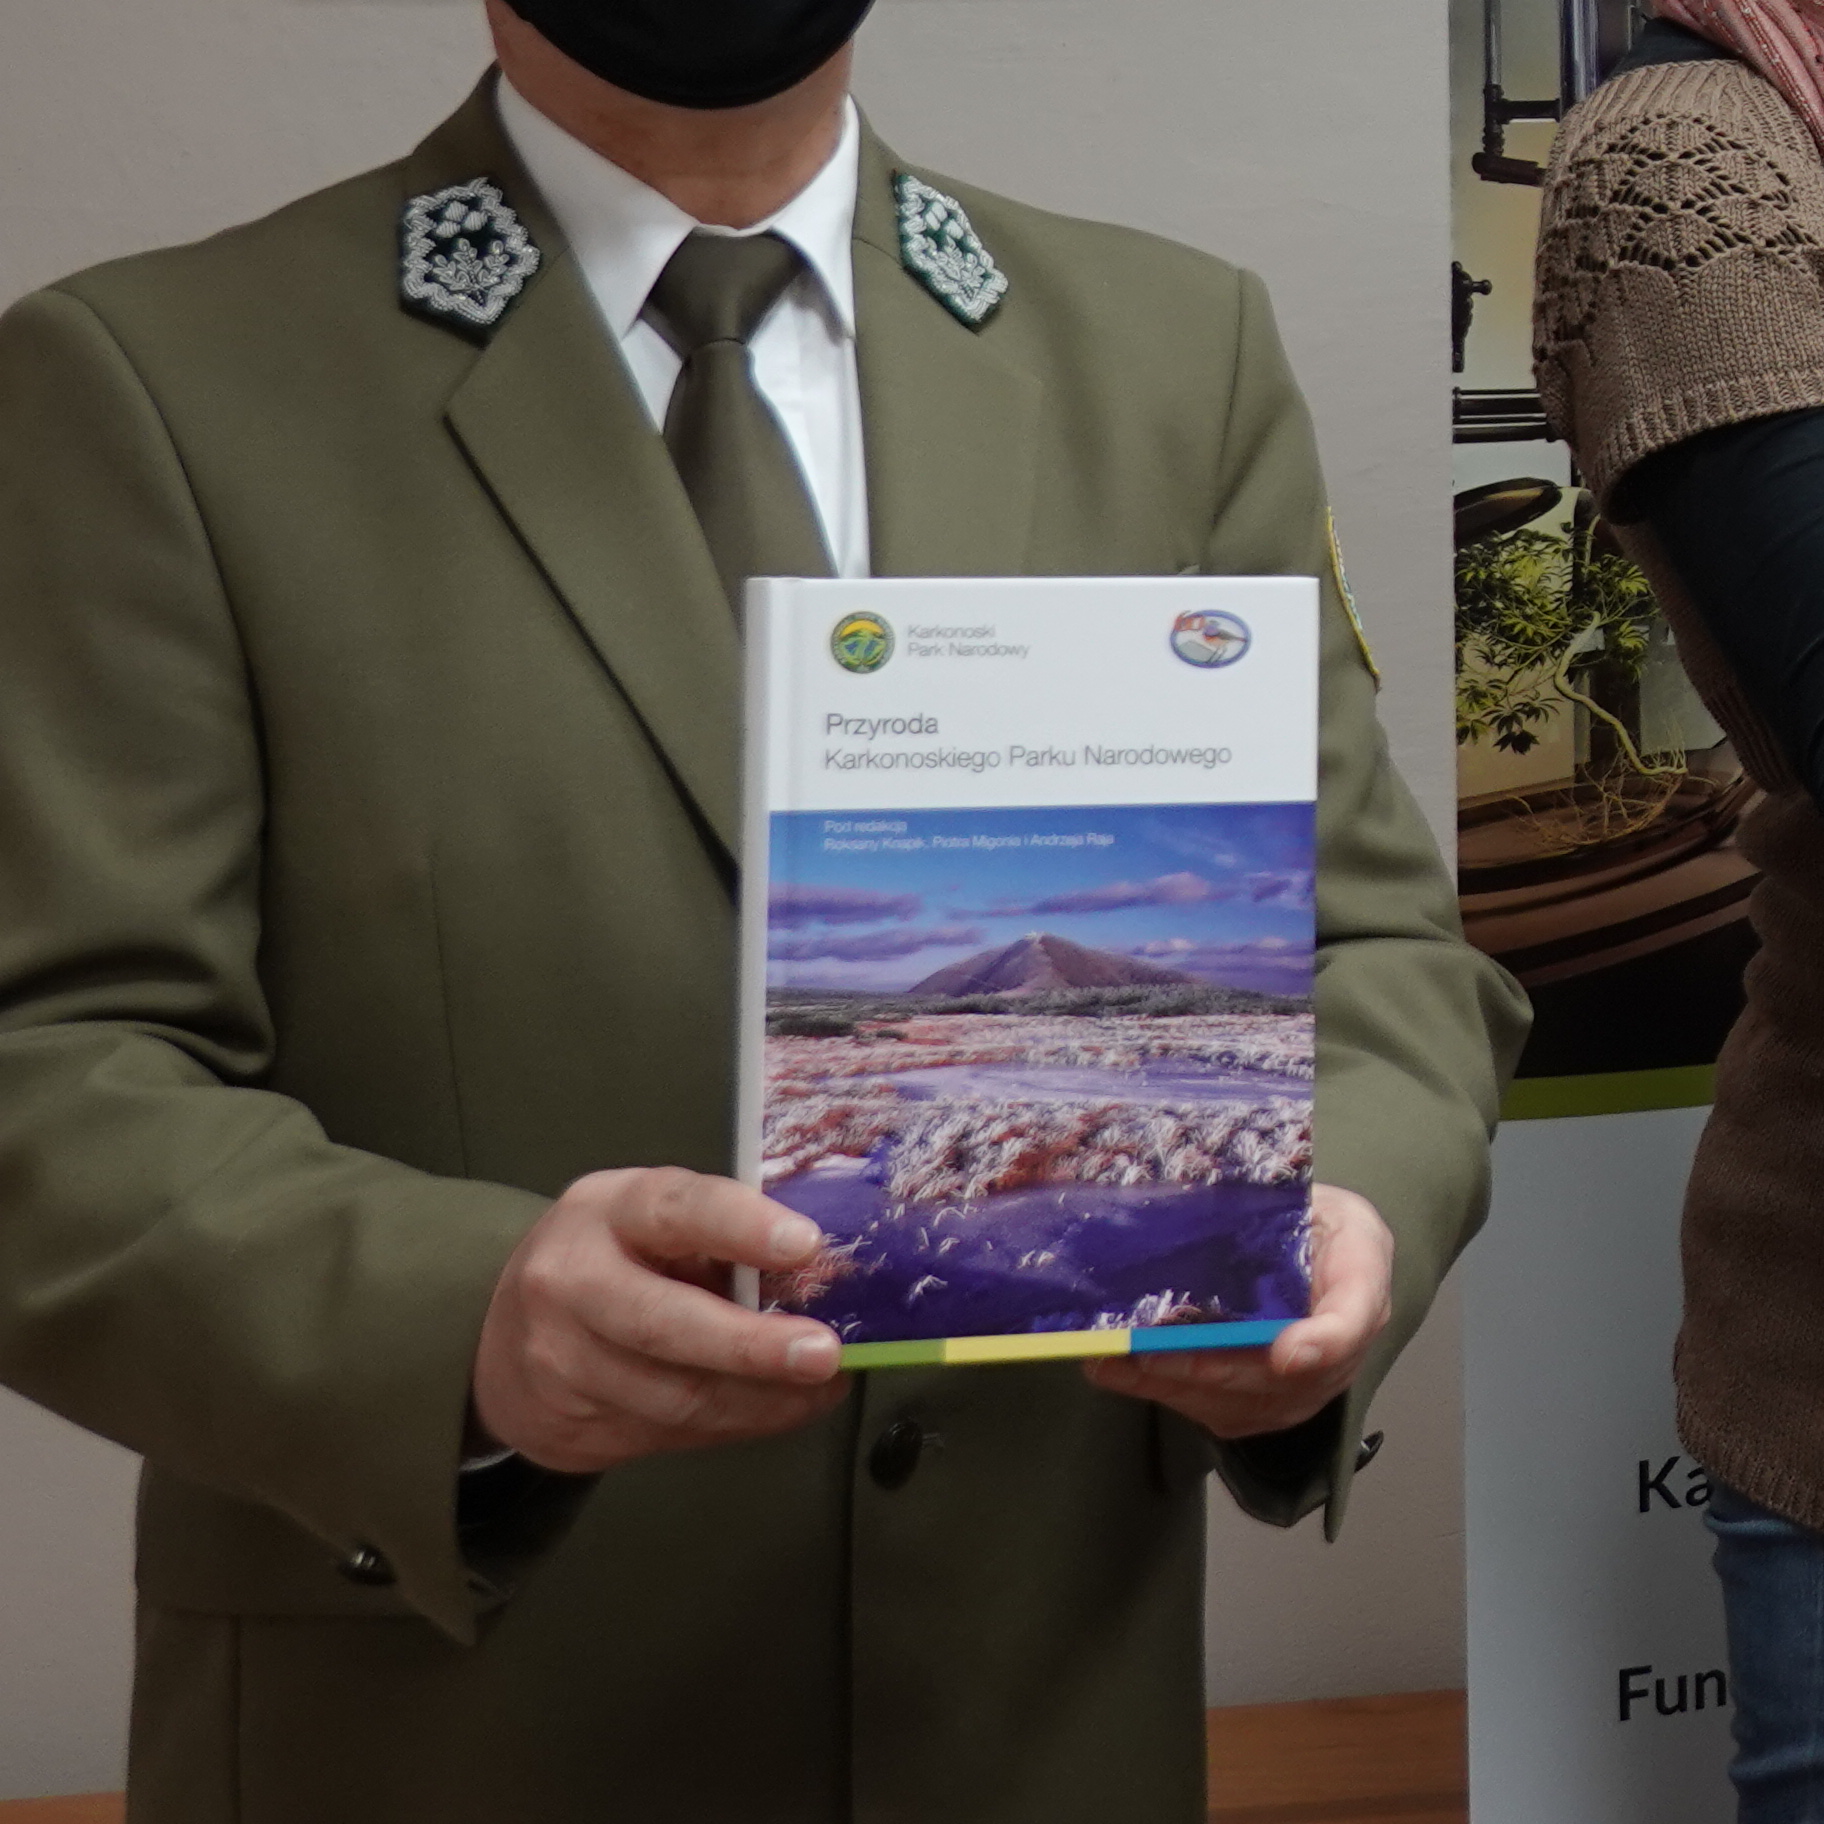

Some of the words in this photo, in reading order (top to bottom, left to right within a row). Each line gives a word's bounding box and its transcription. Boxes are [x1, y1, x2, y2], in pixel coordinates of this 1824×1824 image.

[907, 625, 995, 639] Karkonoski
[907, 642, 944, 657] Park
[949, 642, 1029, 659] Narodowy
[826, 713, 938, 740] Przyroda
[825, 747, 1001, 773] Karkonoskiego
[1009, 745, 1075, 767] Parku
[1084, 745, 1232, 769] Narodowego
